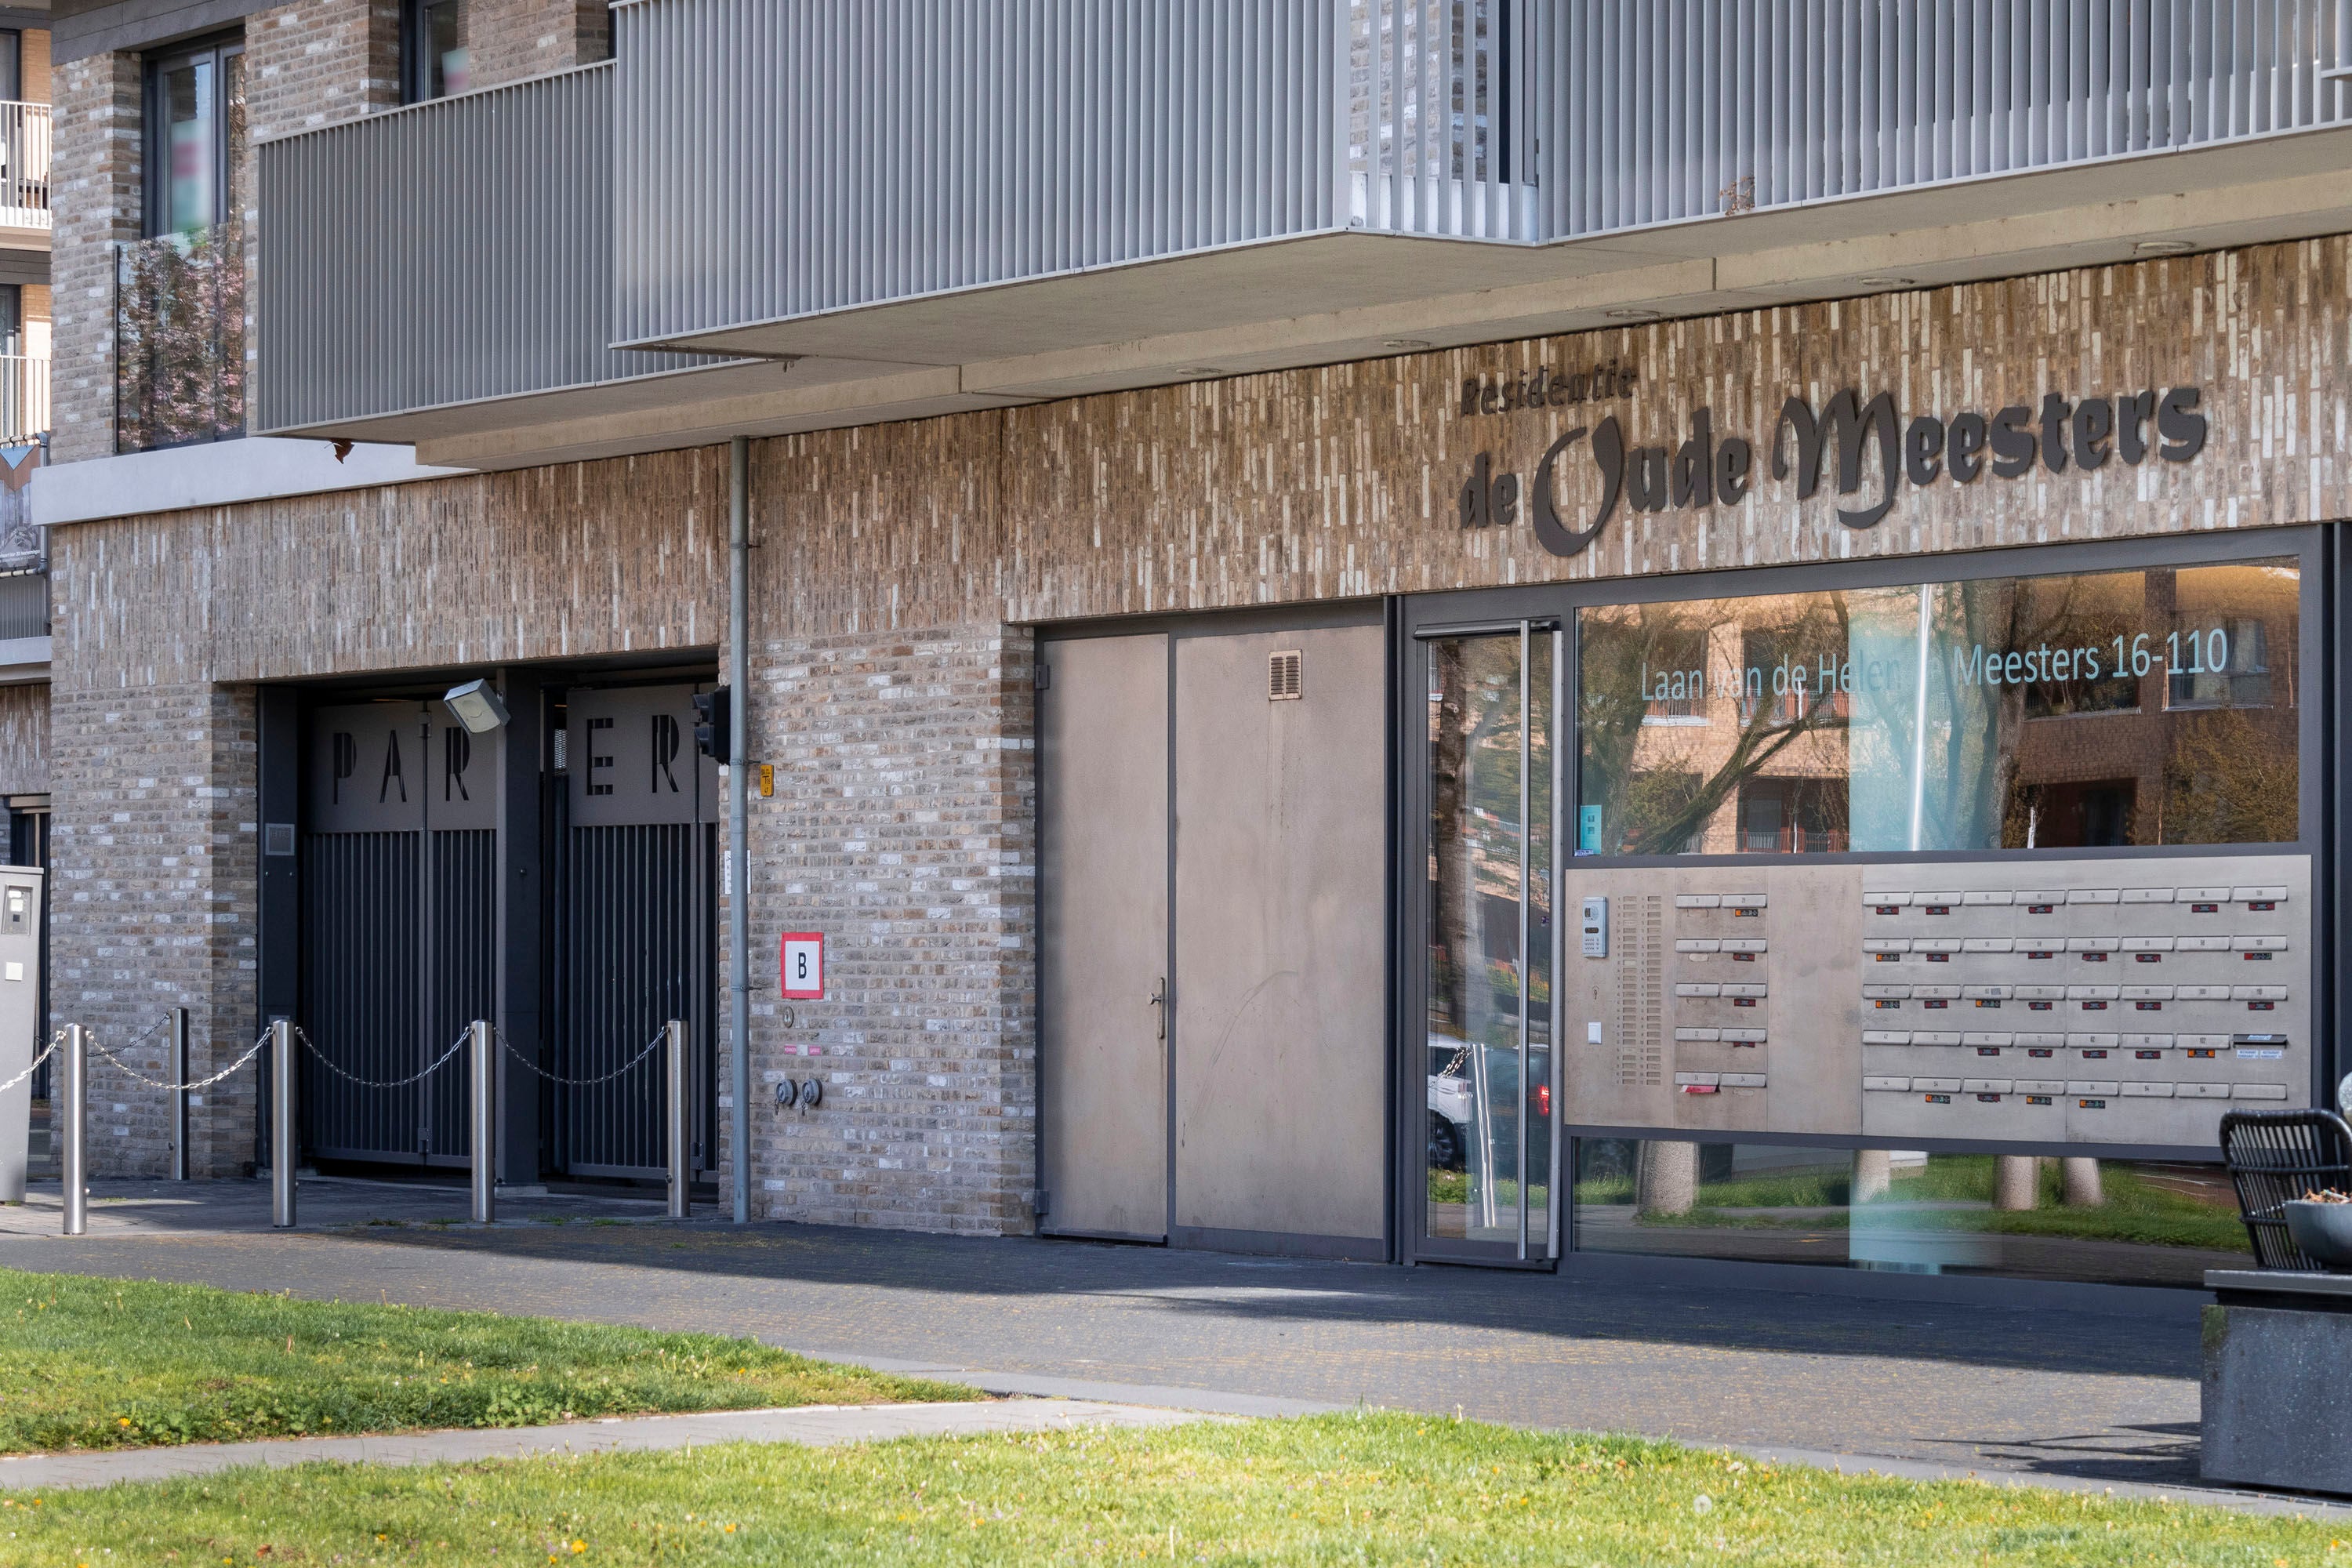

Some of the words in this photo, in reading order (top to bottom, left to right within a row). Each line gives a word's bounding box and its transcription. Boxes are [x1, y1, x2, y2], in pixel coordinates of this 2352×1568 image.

[1461, 359, 1635, 417] Residentie
[1460, 452, 1516, 529] de
[1532, 407, 1748, 557] Oude
[1772, 387, 2206, 529] Meesters
[1642, 662, 1704, 701] Laan
[1712, 665, 1762, 699] van
[1773, 653, 1806, 696] de
[1953, 643, 2100, 685] Meesters
[2112, 628, 2227, 677] 16-110
[798, 952, 807, 979] B
